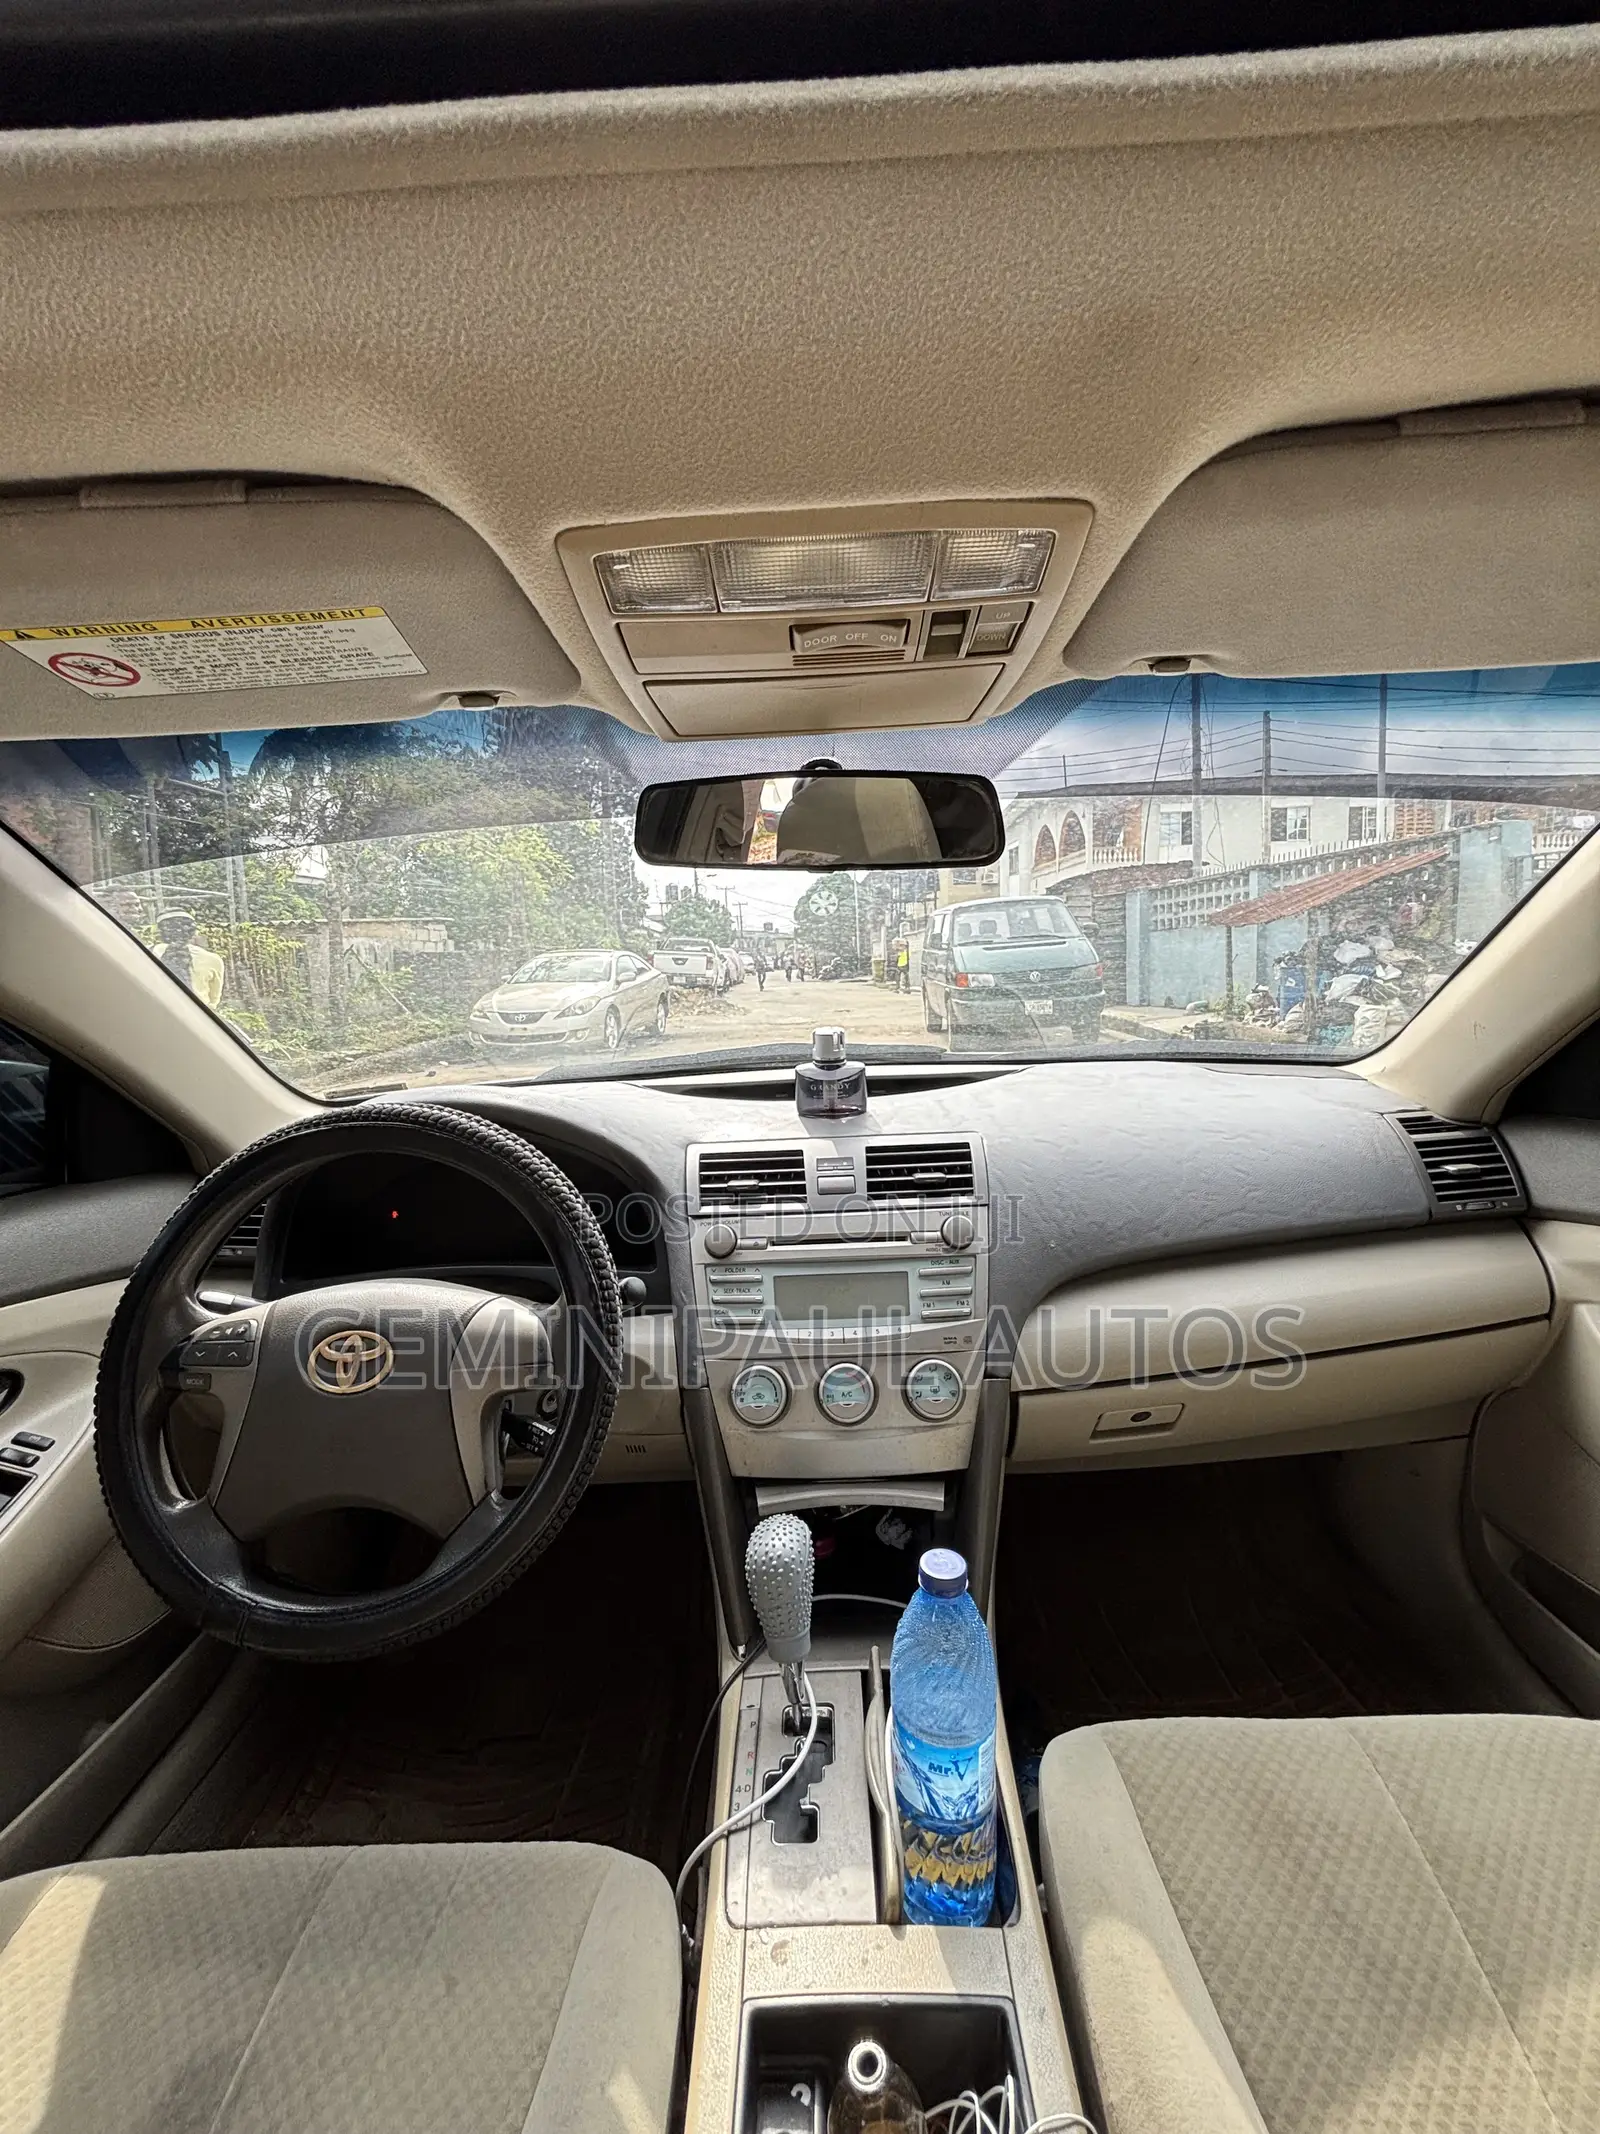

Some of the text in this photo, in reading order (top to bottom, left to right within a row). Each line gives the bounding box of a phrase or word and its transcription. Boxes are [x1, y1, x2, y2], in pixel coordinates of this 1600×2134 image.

[49, 609, 367, 636] WARNING AVERTISSEMENT
[110, 635, 149, 644] DEATH
[170, 631, 221, 639] SERIOUS
[224, 628, 264, 636] INJURY
[804, 633, 897, 648] DOOR OFF ON
[747, 1751, 755, 1759] R
[745, 1768, 753, 1776] N
[734, 1802, 740, 1811] 3
